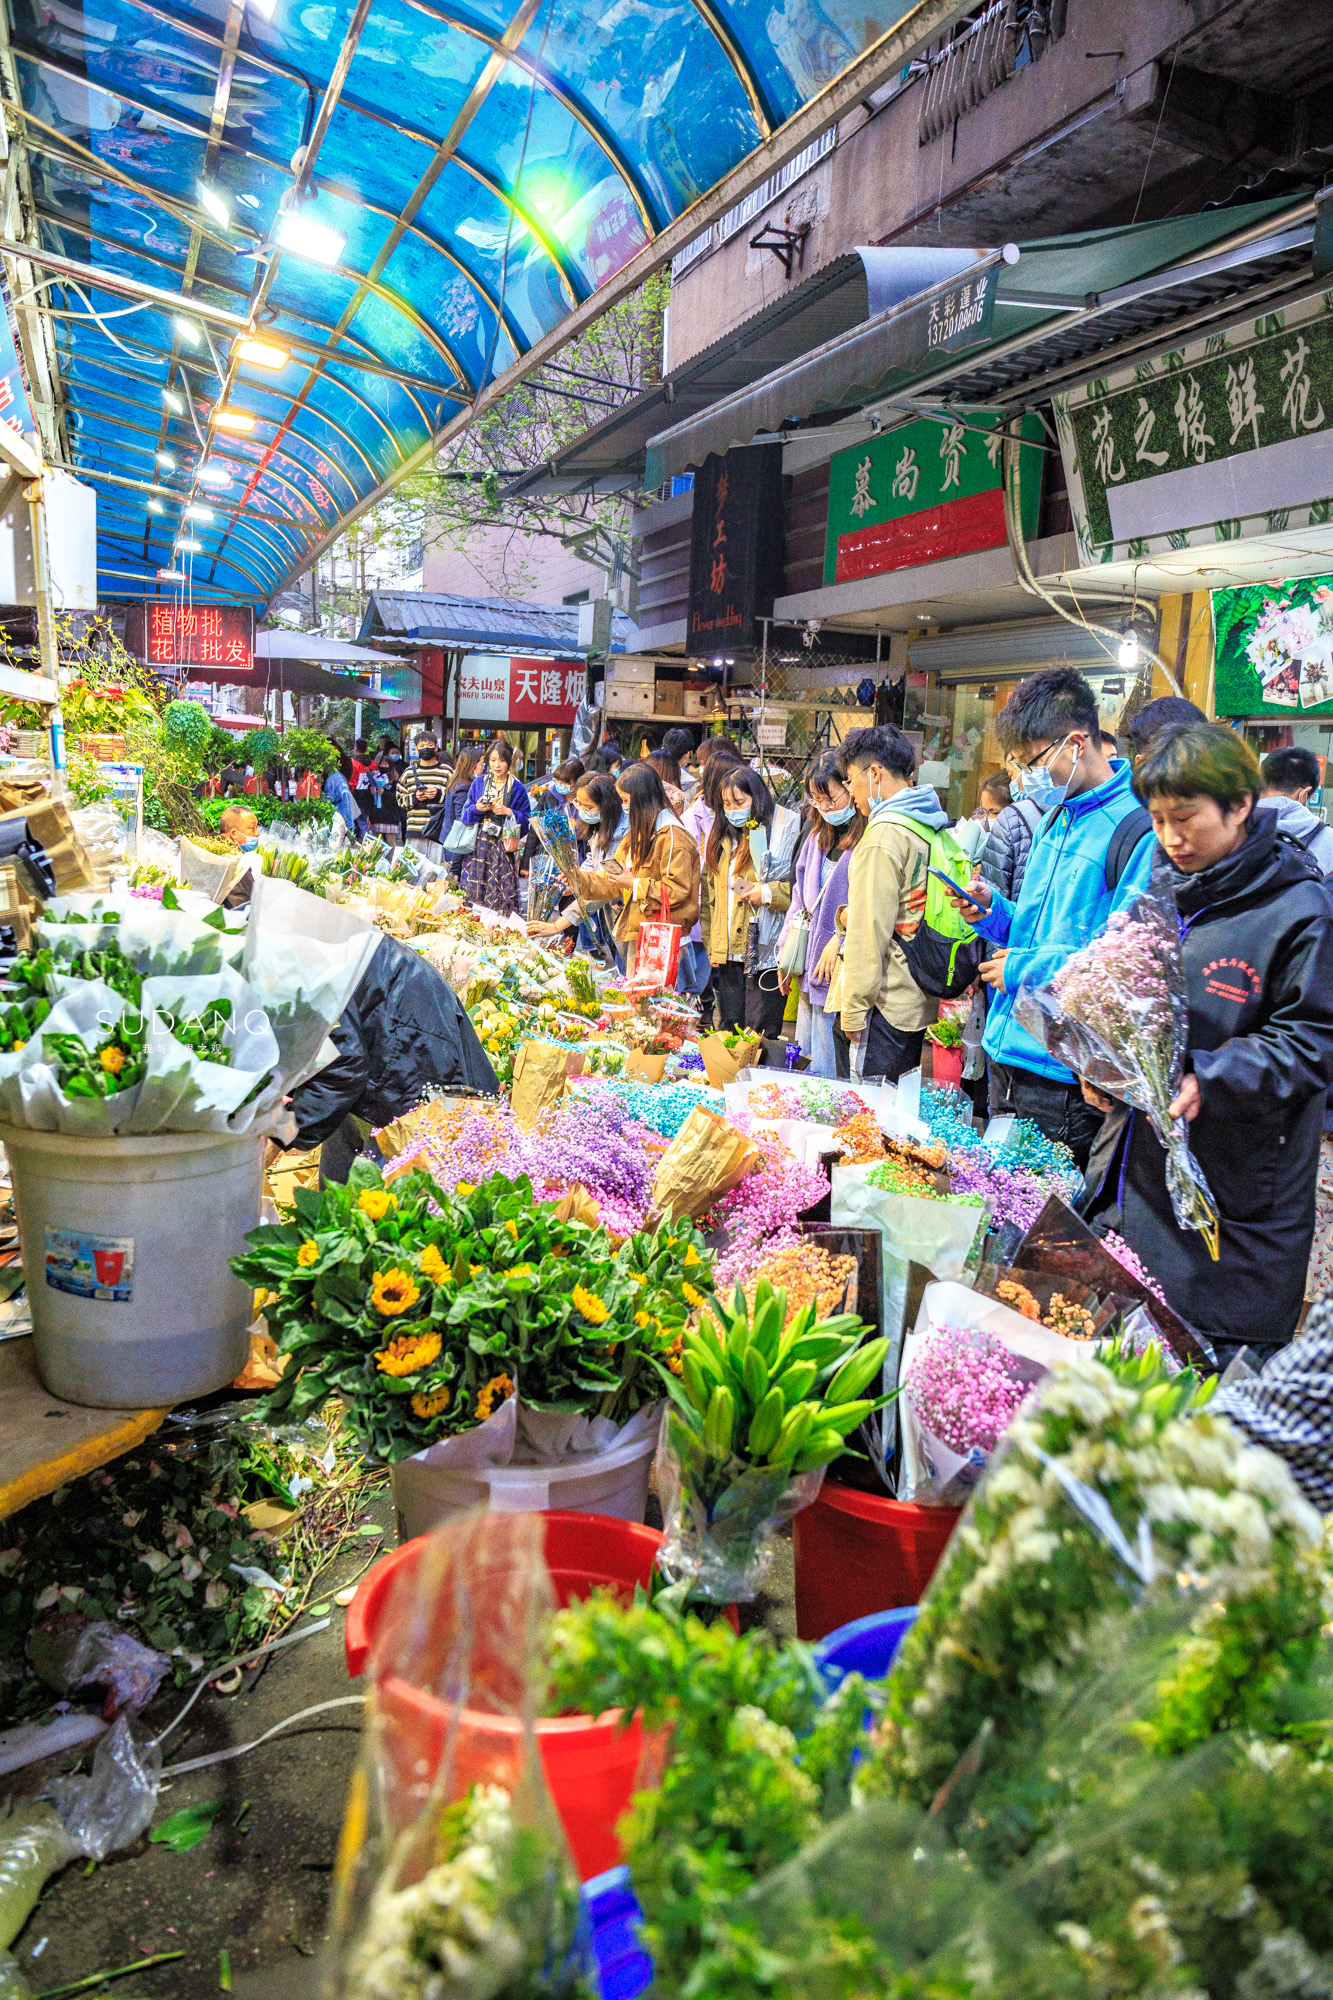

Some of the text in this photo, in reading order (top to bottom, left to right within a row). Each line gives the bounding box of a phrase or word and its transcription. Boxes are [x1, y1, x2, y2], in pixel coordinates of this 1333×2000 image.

[1092, 336, 1325, 485] 花之缘鲜花
[481, 692, 505, 700] SPRING
[515, 669, 587, 708] 天隆烟
